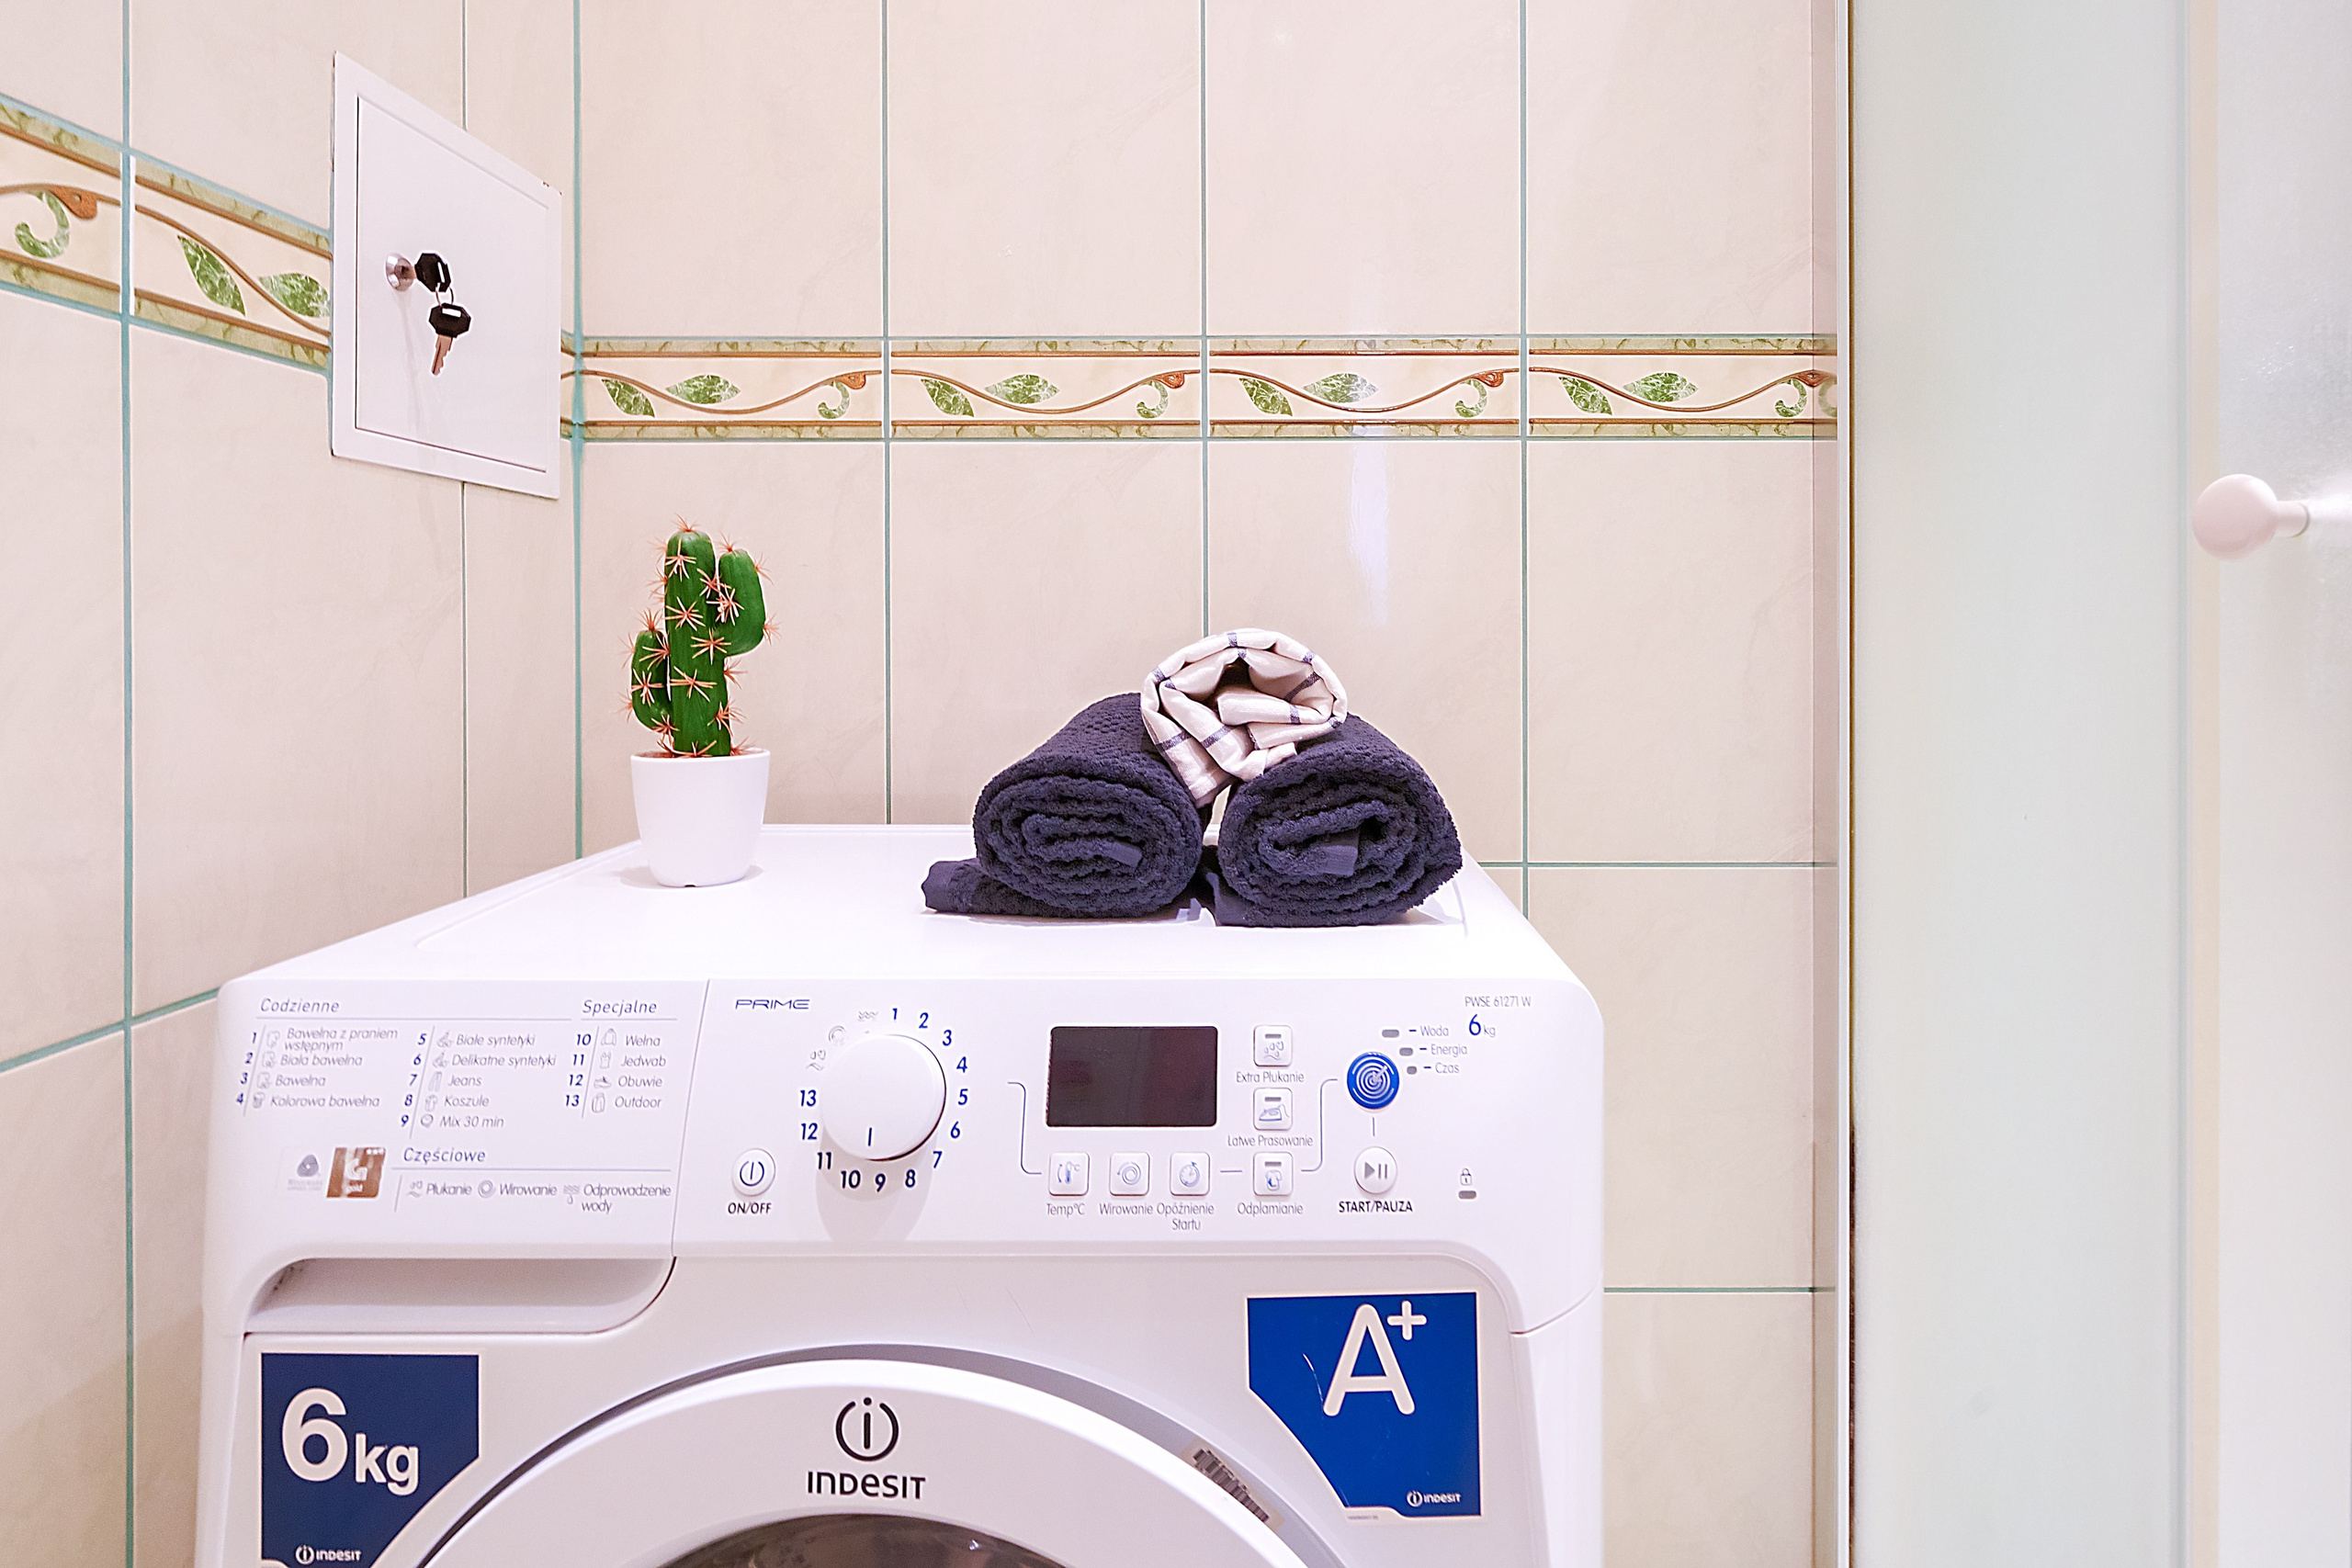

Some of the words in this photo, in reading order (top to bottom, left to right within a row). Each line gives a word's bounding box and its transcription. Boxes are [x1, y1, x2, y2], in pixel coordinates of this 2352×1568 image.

[260, 998, 340, 1012] Codzienne
[582, 999, 658, 1017] Specjalne
[735, 999, 810, 1010] PRIME
[1464, 996, 1491, 1008] PWSE
[1493, 996, 1519, 1008] 61271
[1520, 996, 1532, 1008] W
[892, 1008, 899, 1021] 1
[918, 1012, 929, 1029] 2
[251, 1032, 257, 1044] 1
[338, 1029, 346, 1040] z
[348, 1028, 398, 1043] praniem
[942, 1029, 953, 1046] 3
[1420, 1025, 1449, 1037] Woda
[284, 1040, 344, 1054] wstępnym
[417, 1032, 427, 1045] 5
[486, 1034, 536, 1049] syntetyki
[575, 1033, 592, 1046] 10
[1430, 1043, 1468, 1057] Energia
[244, 1052, 254, 1065] 2
[413, 1053, 422, 1066] 6
[452, 1055, 504, 1066] Delikatne
[507, 1055, 557, 1069] syntetyki
[572, 1054, 585, 1066] 11
[620, 1055, 666, 1067] Jedwab
[956, 1056, 968, 1073] 4
[1435, 1063, 1460, 1074] Czas
[240, 1072, 248, 1085] 3
[409, 1073, 418, 1087] 7
[448, 1074, 482, 1087] Jeans
[568, 1074, 584, 1087] 12
[617, 1075, 663, 1088] Obuwie
[1236, 1071, 1260, 1083] Extra
[235, 1092, 244, 1105] 4
[270, 1095, 325, 1108] Kolorowa
[404, 1093, 413, 1107] 8
[444, 1094, 490, 1108] Koszule
[565, 1094, 580, 1107] 13
[615, 1095, 662, 1109] Outdoor
[799, 1089, 817, 1107] 13
[958, 1089, 968, 1106] 5
[401, 1114, 409, 1127] 9
[439, 1115, 461, 1128] Mix
[463, 1115, 480, 1128] 30
[481, 1116, 504, 1128] min
[800, 1122, 818, 1140] 12
[950, 1121, 961, 1139] 6
[1258, 1134, 1314, 1146] Prasowanie
[403, 1147, 486, 1165] Częściowe
[817, 1152, 831, 1169] 11
[933, 1150, 943, 1168] 7
[841, 1169, 861, 1189] 10
[875, 1173, 887, 1192] 9
[904, 1168, 916, 1188] 8
[499, 1182, 558, 1196] Wirowanie
[583, 1183, 672, 1198] Odprowadzenie
[582, 1199, 613, 1214] wody
[728, 1202, 772, 1214] ON/OFF
[1099, 1202, 1154, 1216] Wirowanie
[1156, 1201, 1215, 1218] Opóźnienie
[1237, 1201, 1304, 1217] Odplamianie
[1339, 1201, 1413, 1213] START/PAUZA
[1171, 1217, 1202, 1231] Startu
[1323, 1300, 1428, 1416] A+
